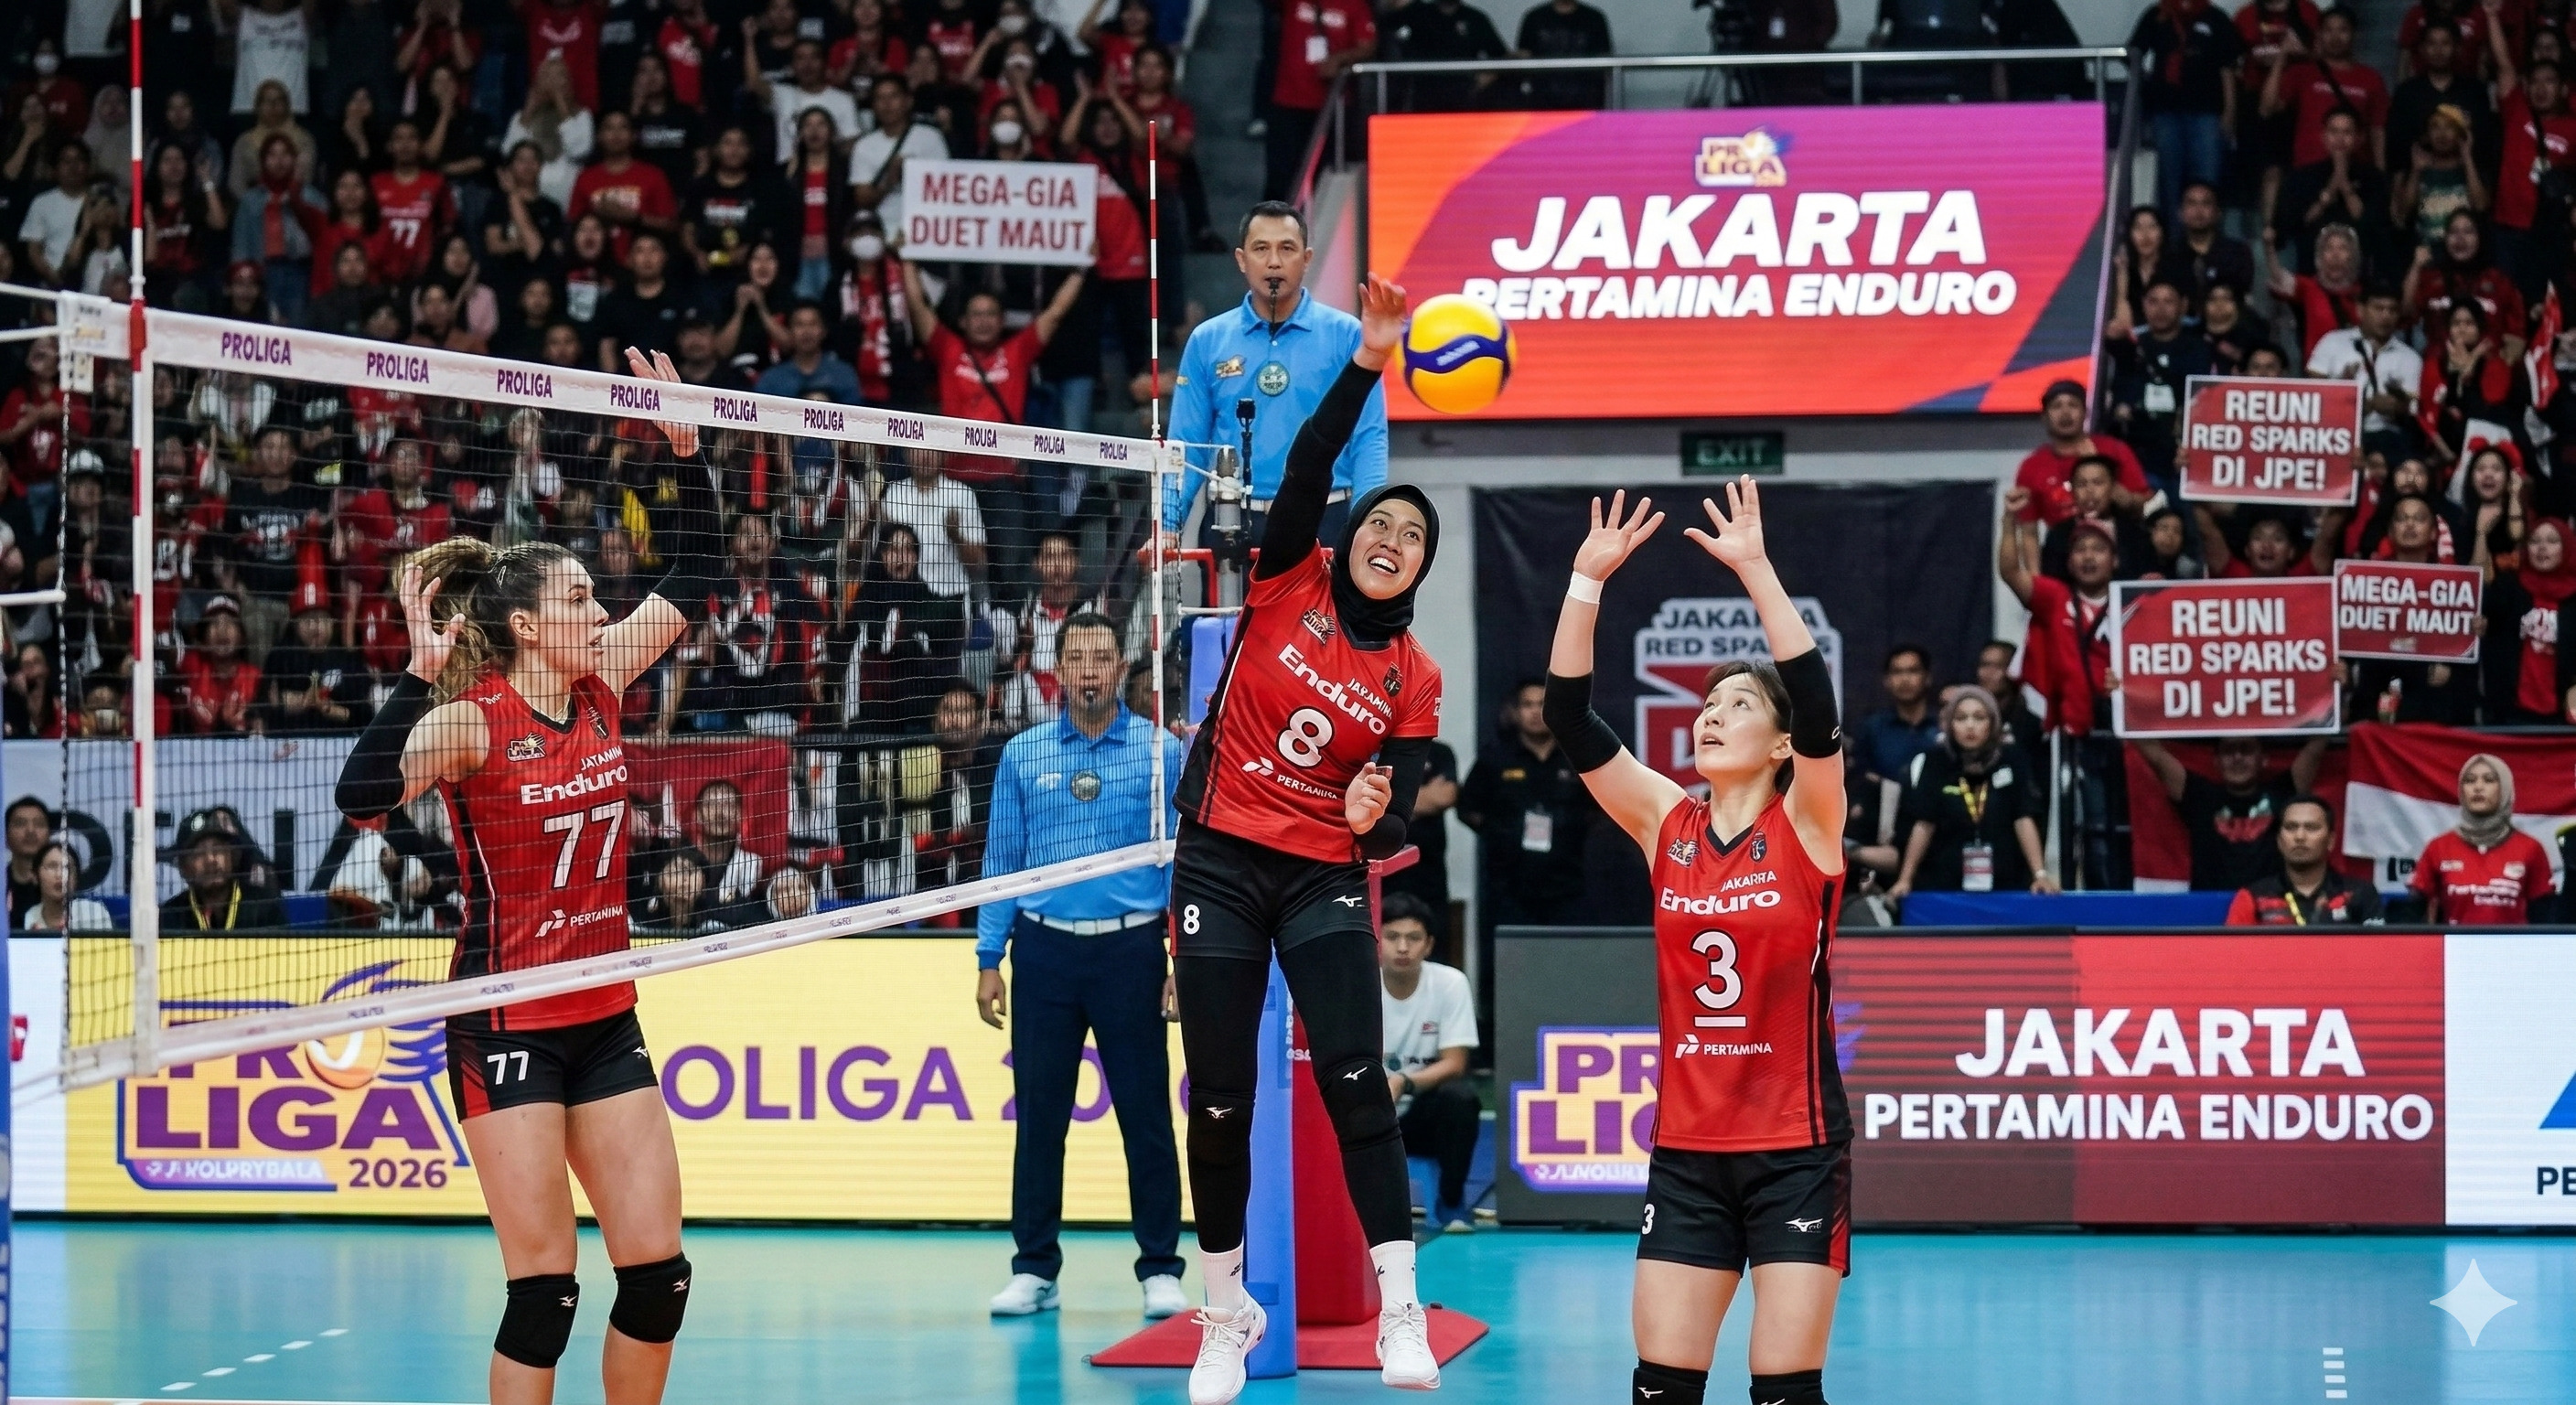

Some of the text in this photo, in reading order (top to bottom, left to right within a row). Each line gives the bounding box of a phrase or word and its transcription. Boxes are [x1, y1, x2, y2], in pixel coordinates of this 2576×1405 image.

[923, 173, 1077, 208] MEGA-GIA
[911, 216, 1086, 250] DUET MAUT
[1491, 190, 1987, 273] JAKARTA
[1464, 271, 2017, 320] PERTAMINA ENDURO
[220, 331, 292, 365] PROLIGA
[367, 351, 429, 383] PROLIGA
[497, 369, 553, 398] PROLIGA
[611, 384, 660, 411] PROLIGA
[714, 397, 757, 423] PROLIGA
[2225, 390, 2321, 424] REUNI
[804, 408, 844, 432] PROLIGA
[1697, 440, 1766, 466] EXIT
[2191, 424, 2351, 456] RED SPARKS
[2212, 456, 2326, 491] DI JPE!
[2340, 574, 2474, 607] MEGA-GIA
[1663, 607, 1819, 628] JAKAA
[2172, 597, 2285, 638] REUNI
[2339, 605, 2472, 636] DUET MAUT
[1646, 637, 1833, 656] RED SPAS
[2129, 638, 2326, 675] RED SPARKS
[1278, 643, 1386, 735] Enduro
[2163, 679, 2296, 718] DI JPE!
[1277, 707, 1334, 767] 8
[521, 765, 628, 805] Enduro
[544, 799, 625, 888] 77
[1660, 886, 1781, 915] Enduro
[1184, 904, 1200, 935] 8
[1691, 928, 1742, 1010] 3
[1704, 1043, 1773, 1056] PERTAMINA
[1955, 1008, 2366, 1078] JAKARTA
[487, 1050, 530, 1085] 77
[661, 1045, 972, 1121] OLIGA
[137, 1086, 441, 1151] LIGA
[1865, 1094, 2433, 1141] PERTAMINA ENDURO
[349, 1158, 447, 1188] 2026
[1642, 1204, 1655, 1235] 3
